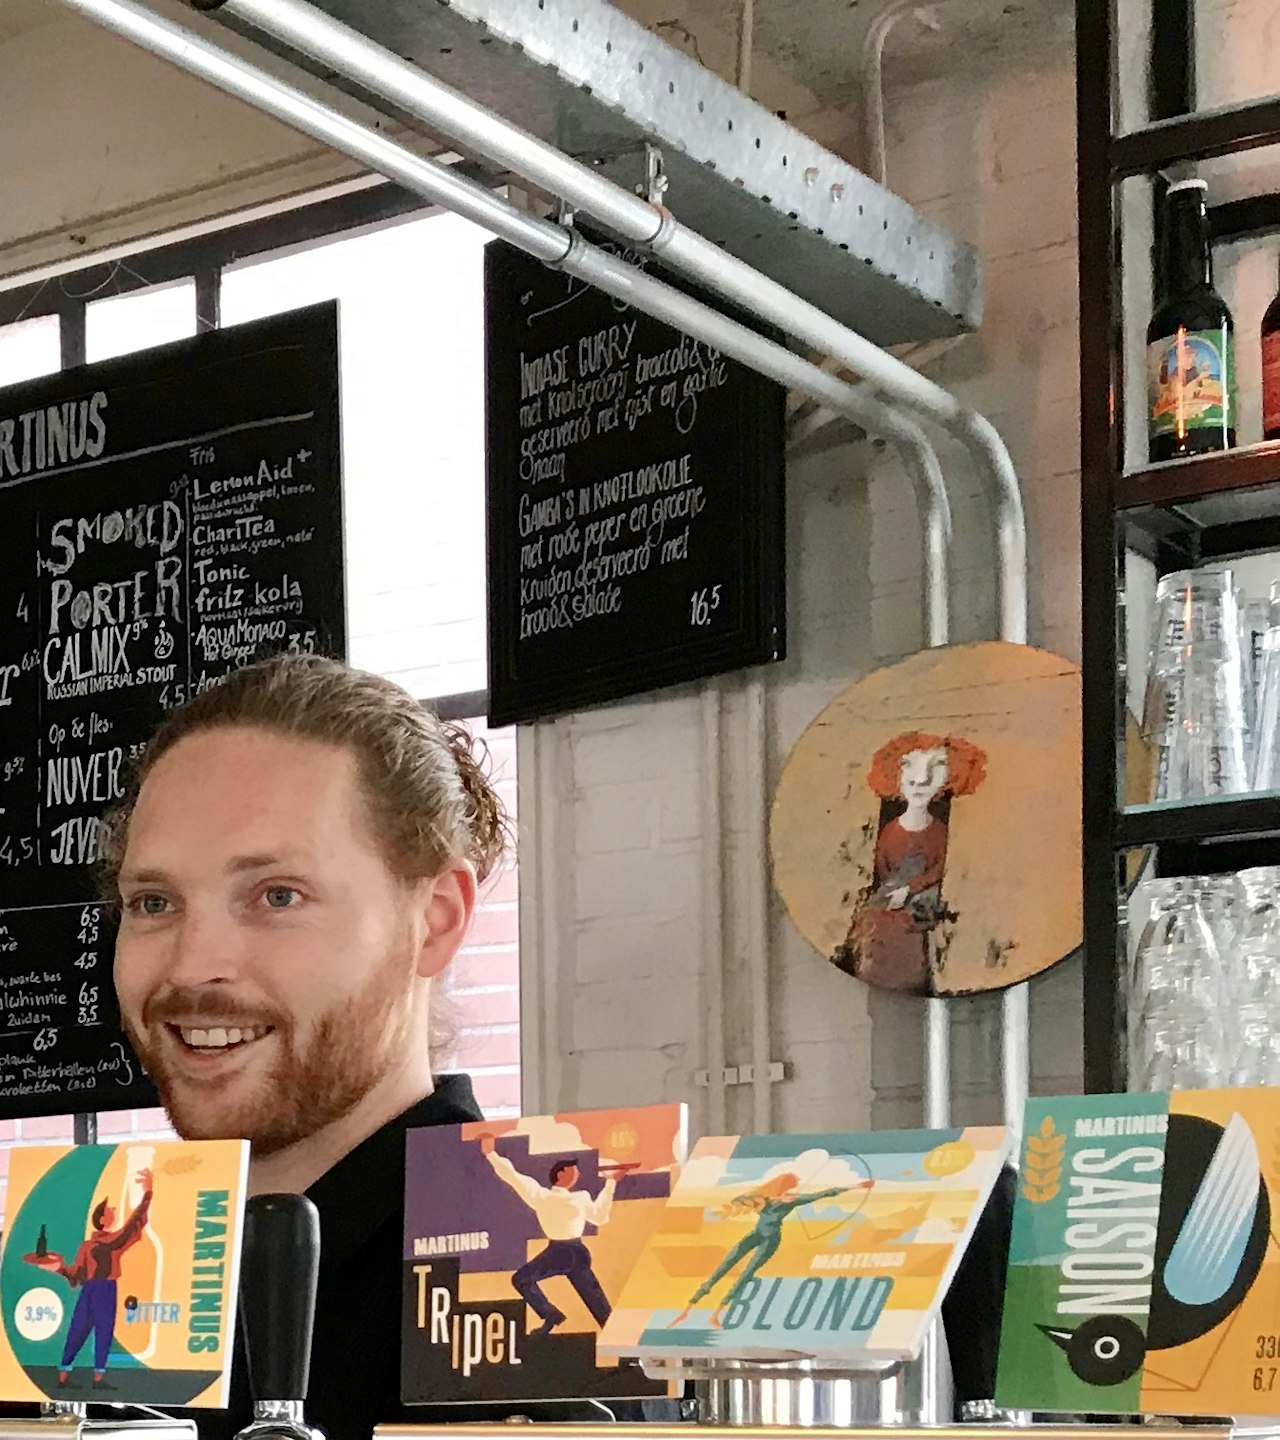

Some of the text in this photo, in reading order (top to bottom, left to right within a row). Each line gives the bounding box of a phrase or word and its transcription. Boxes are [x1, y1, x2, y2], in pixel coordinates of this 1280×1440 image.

[579, 320, 636, 377] CURRY
[660, 380, 676, 408] en
[579, 487, 589, 515] IN
[41, 501, 184, 576] SMOKED
[193, 515, 274, 545] ChariTea
[520, 534, 543, 572] met
[549, 522, 580, 561] rode
[583, 512, 626, 565] peper
[630, 503, 647, 532] en
[660, 526, 689, 564] met
[194, 558, 250, 585] Tonic
[16, 592, 28, 622] 4
[49, 556, 184, 634] PORTER
[43, 624, 131, 683] CALMIX
[47, 679, 88, 700] RUSSIAN
[90, 673, 134, 693] IMPERIAL
[136, 664, 177, 684] STOUT
[49, 724, 65, 752] Op
[47, 747, 125, 807] NUVER
[414, 1231, 489, 1256] MARTINUS
[1057, 1147, 1165, 1314] SAISON
[188, 1190, 229, 1354] MARTINUS
[723, 1276, 895, 1331] BLOND
